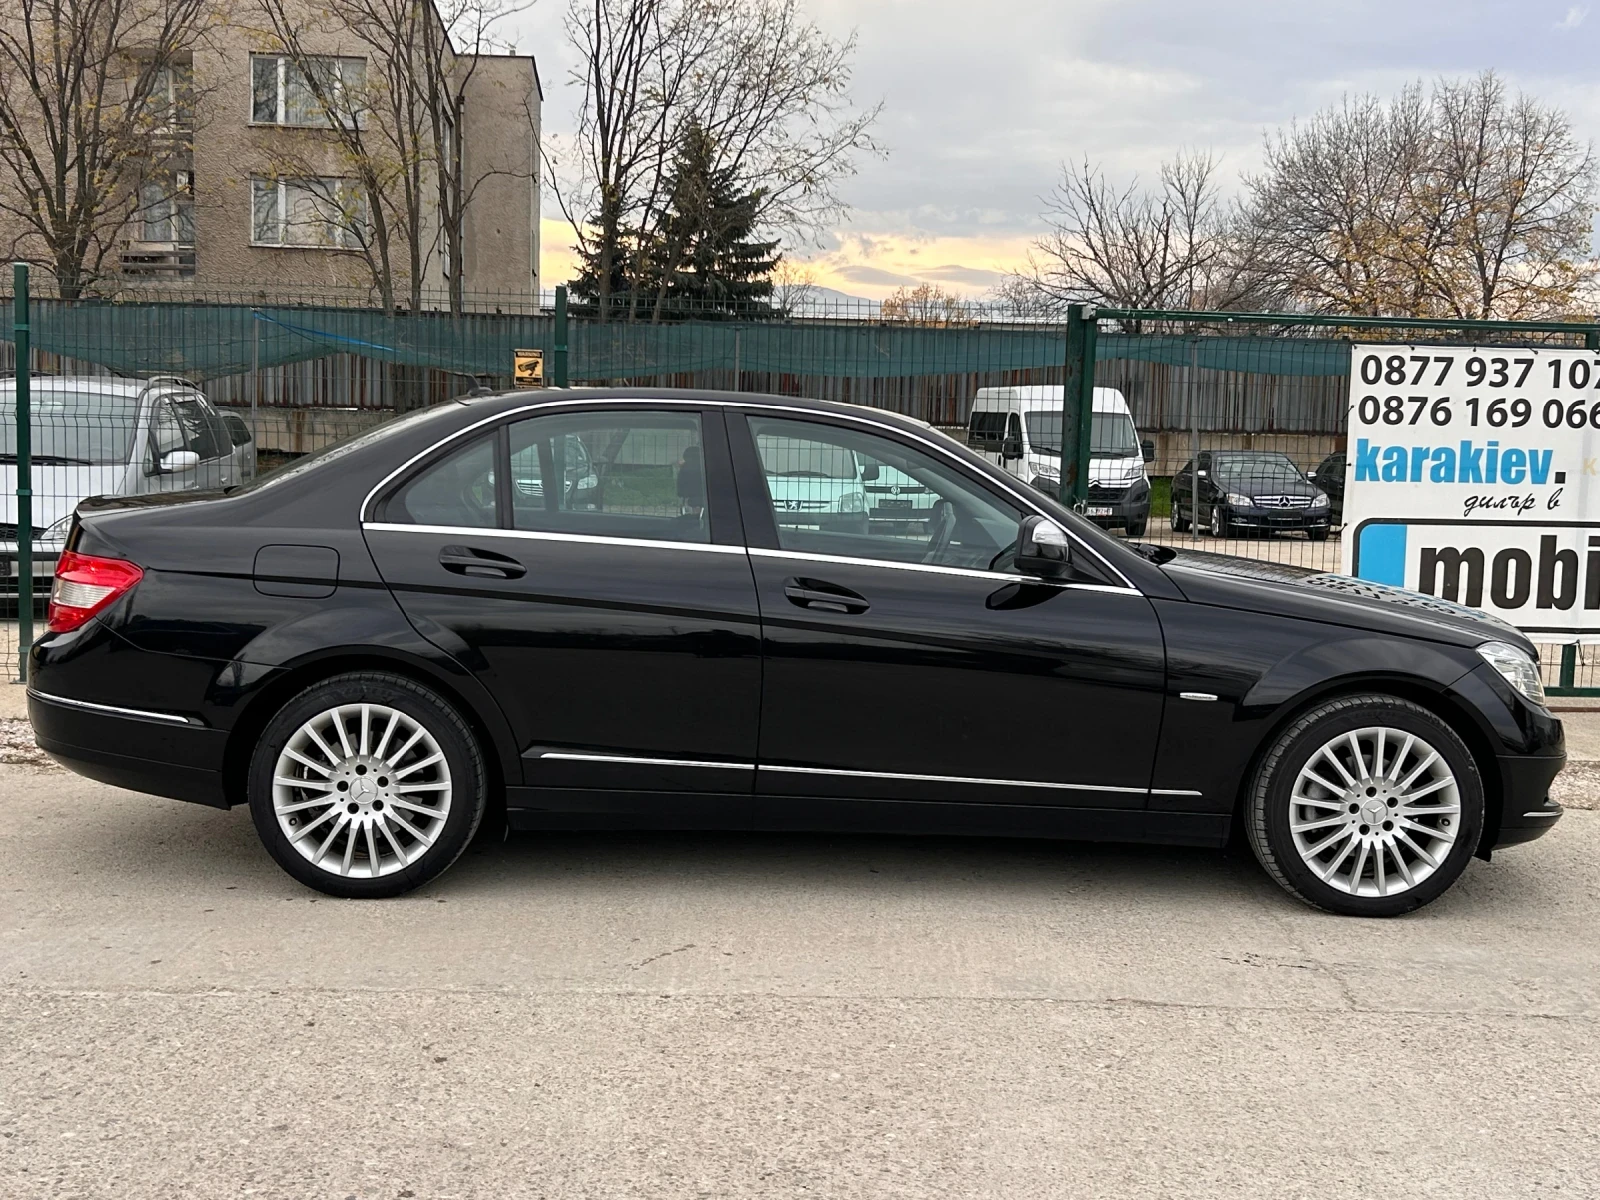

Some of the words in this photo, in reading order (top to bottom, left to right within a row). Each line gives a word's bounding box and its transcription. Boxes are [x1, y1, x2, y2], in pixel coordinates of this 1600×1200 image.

[1361, 355, 1454, 386] 0877
[1465, 357, 1535, 388] 937
[1358, 395, 1452, 426] 0876
[1465, 397, 1532, 428] 169
[1463, 493, 1536, 517] дилър
[1418, 535, 1600, 611] mobi
